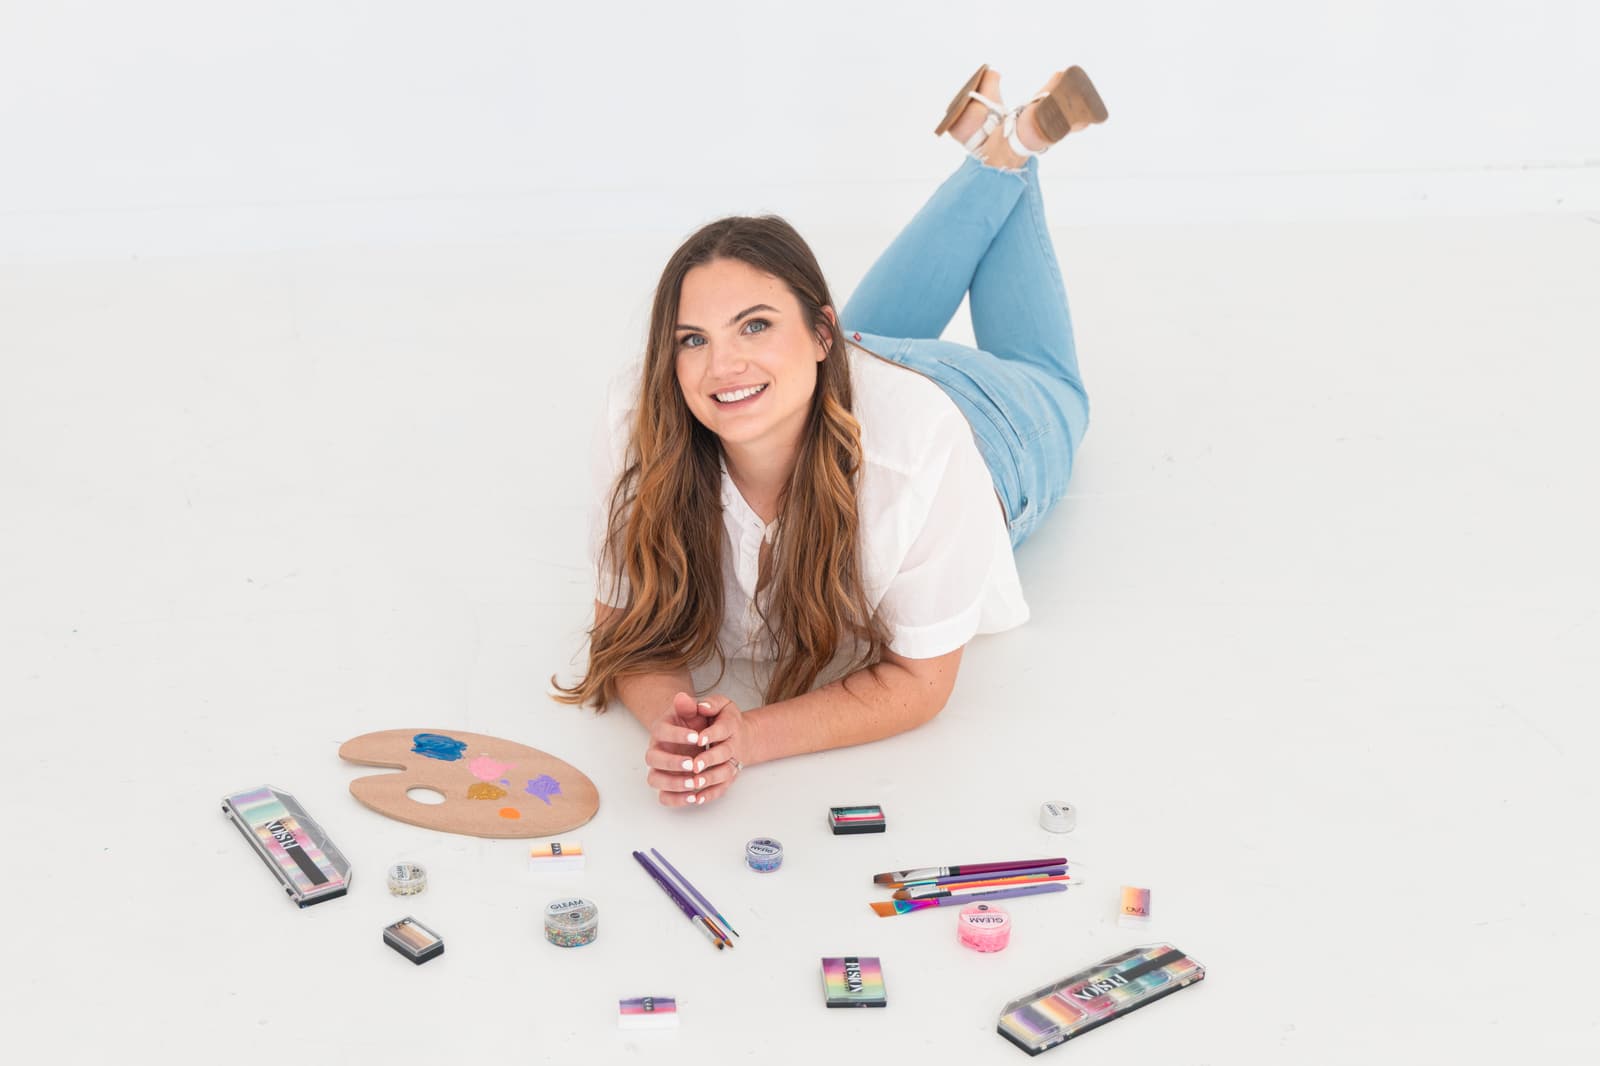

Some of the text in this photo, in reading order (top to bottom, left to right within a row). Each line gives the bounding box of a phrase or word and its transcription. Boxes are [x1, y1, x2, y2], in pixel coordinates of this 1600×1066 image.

[264, 819, 301, 849] FUSION
[550, 899, 583, 909] GLEAM
[846, 962, 863, 992] FUSION
[1072, 973, 1128, 1000] FUSION
